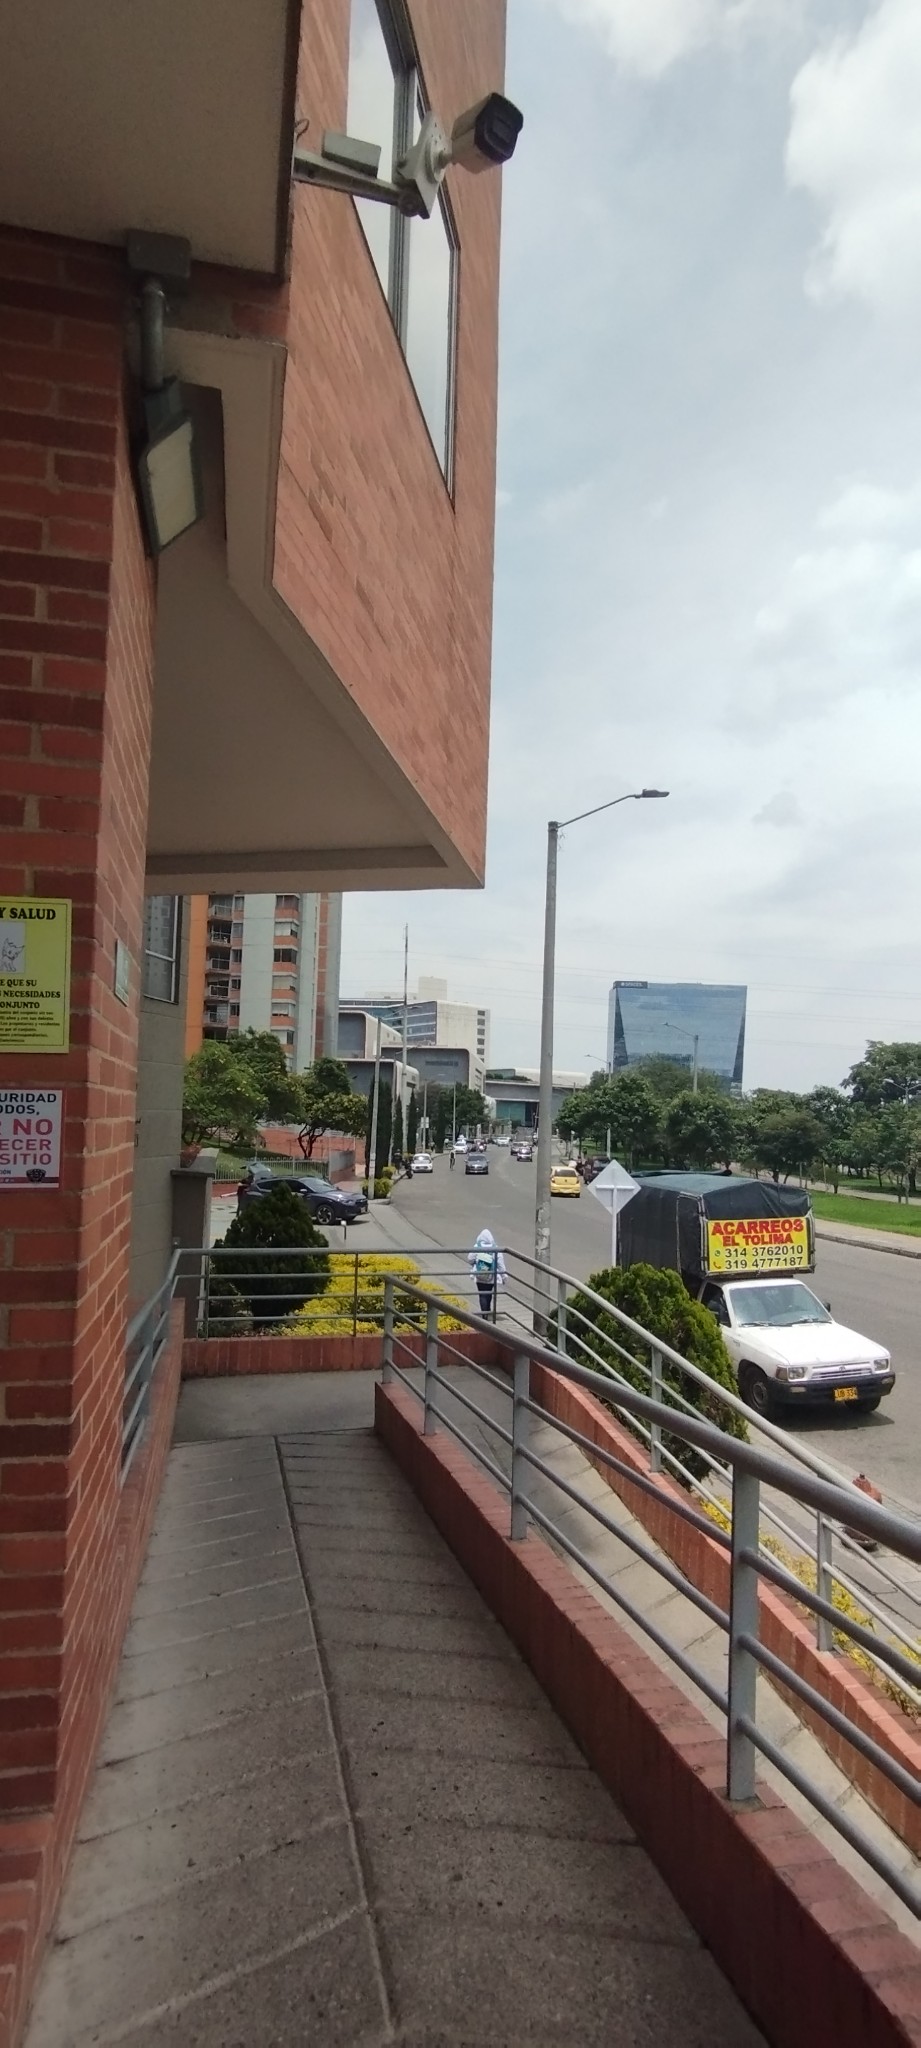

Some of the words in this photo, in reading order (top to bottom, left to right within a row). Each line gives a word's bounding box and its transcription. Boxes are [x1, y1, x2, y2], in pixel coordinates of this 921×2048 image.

[9, 907, 56, 920] SALUD
[7, 979, 24, 988] QUE
[26, 979, 37, 987] SU
[3, 990, 61, 999] NECESIDADES
[13, 1118, 53, 1136] NO
[0, 1153, 52, 1166] SITIO
[711, 1218, 804, 1236] ACARREOS
[722, 1235, 739, 1247] EL
[743, 1233, 794, 1246] TOLIMA
[725, 1248, 747, 1258] 314
[752, 1245, 803, 1257] 3762010
[725, 1259, 748, 1270] 319
[752, 1257, 803, 1268] 4777187
